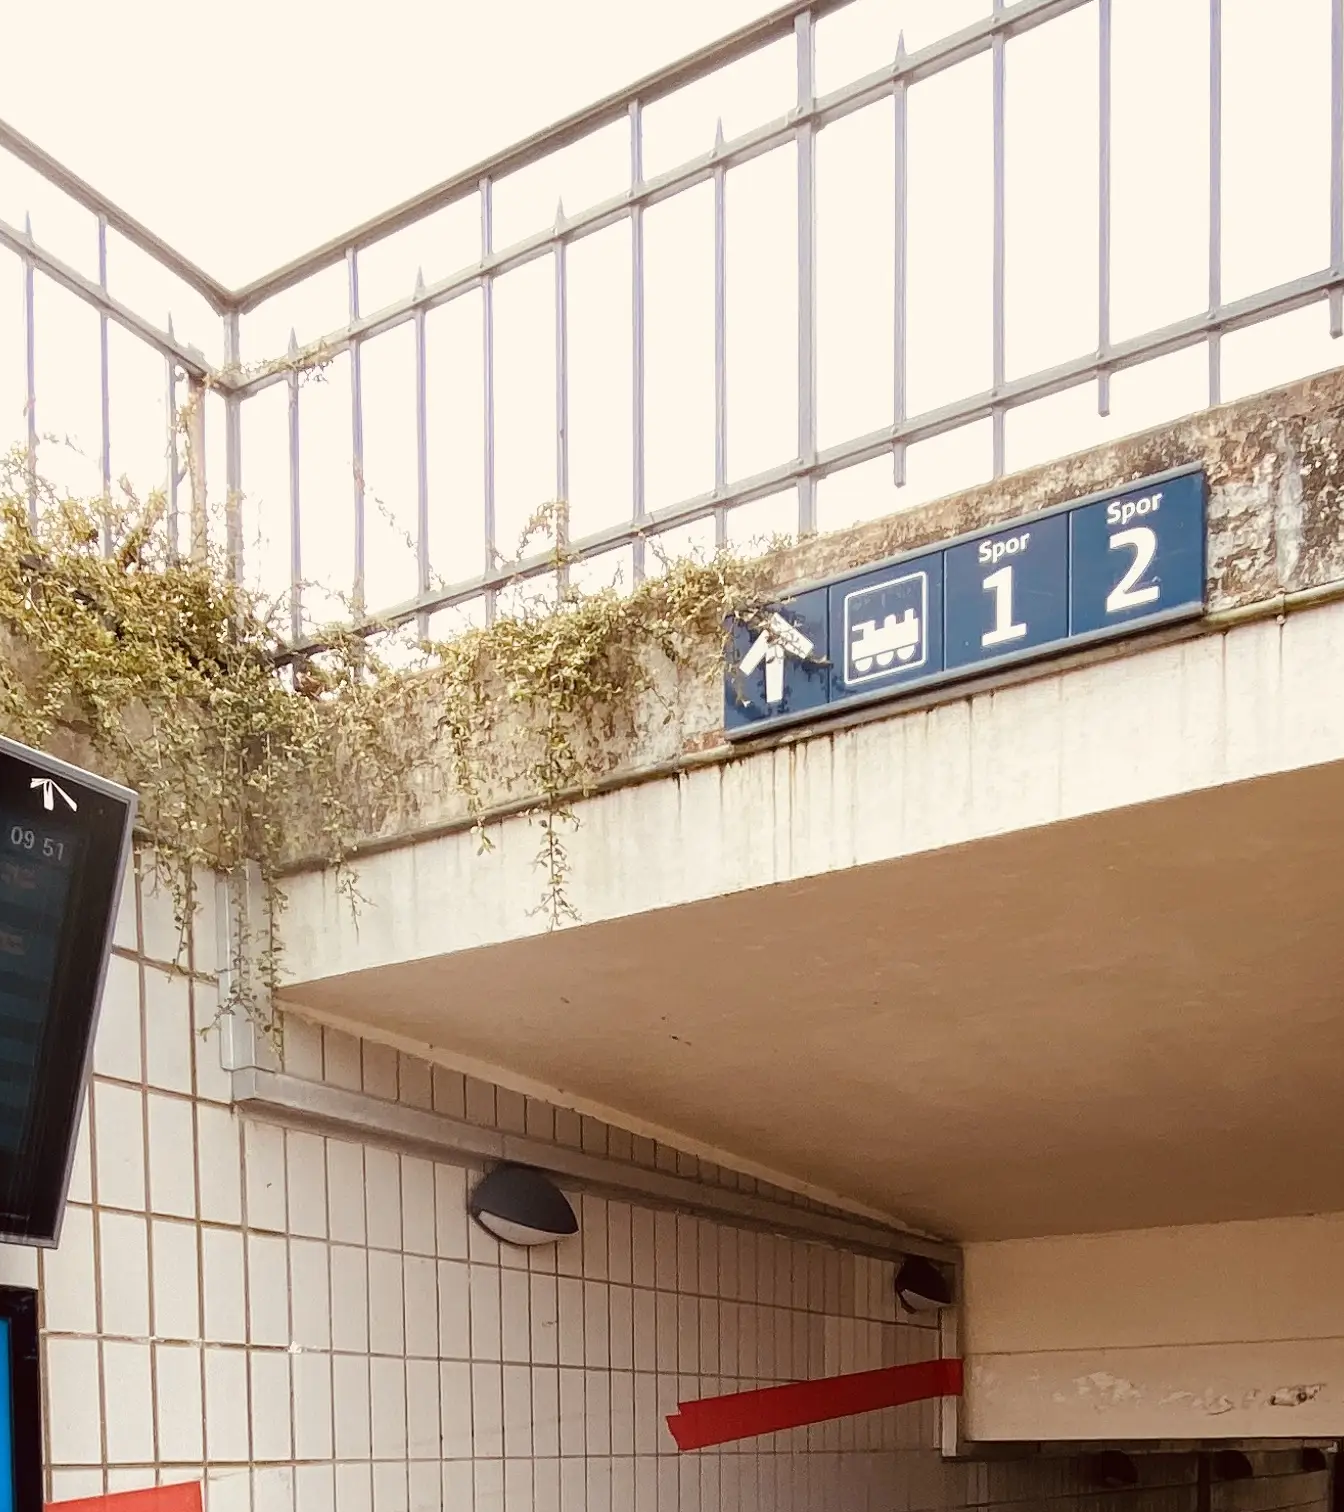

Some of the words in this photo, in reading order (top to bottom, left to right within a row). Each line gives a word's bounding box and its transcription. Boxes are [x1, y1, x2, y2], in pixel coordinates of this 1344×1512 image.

[1105, 492, 1164, 525] Spor
[978, 532, 1031, 565] Spor
[1104, 525, 1161, 613] 2
[979, 565, 1028, 648] 1
[10, 825, 36, 850] 09
[41, 838, 64, 861] 51
